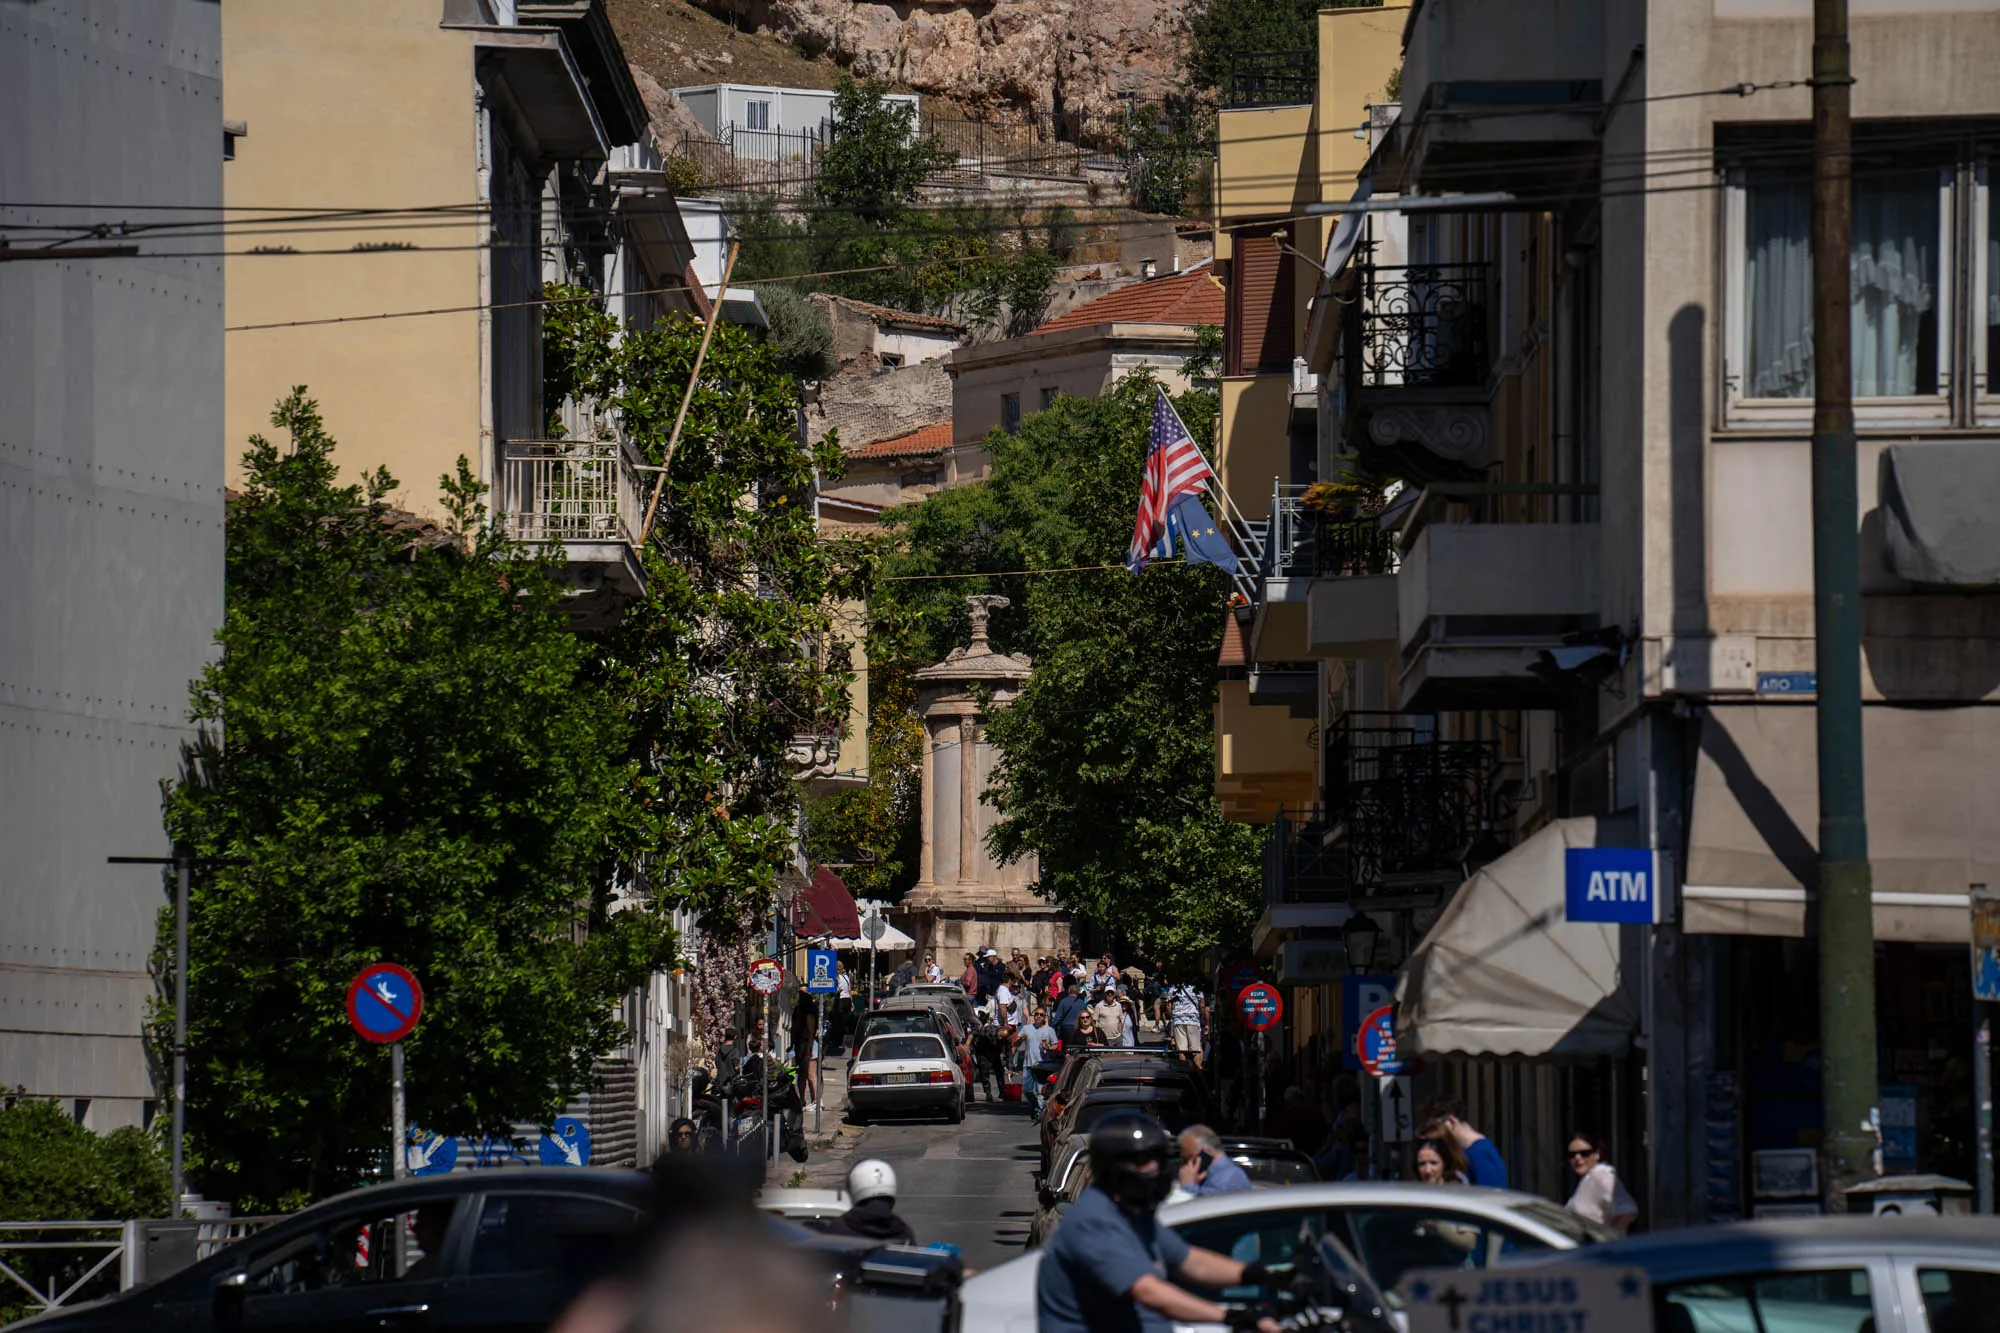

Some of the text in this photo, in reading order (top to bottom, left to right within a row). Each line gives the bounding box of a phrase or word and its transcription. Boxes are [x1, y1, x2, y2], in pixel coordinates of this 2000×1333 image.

[1587, 871, 1647, 902] ATM
[1476, 1278, 1578, 1305] JESUS
[1469, 1309, 1588, 1333] CHRIST
